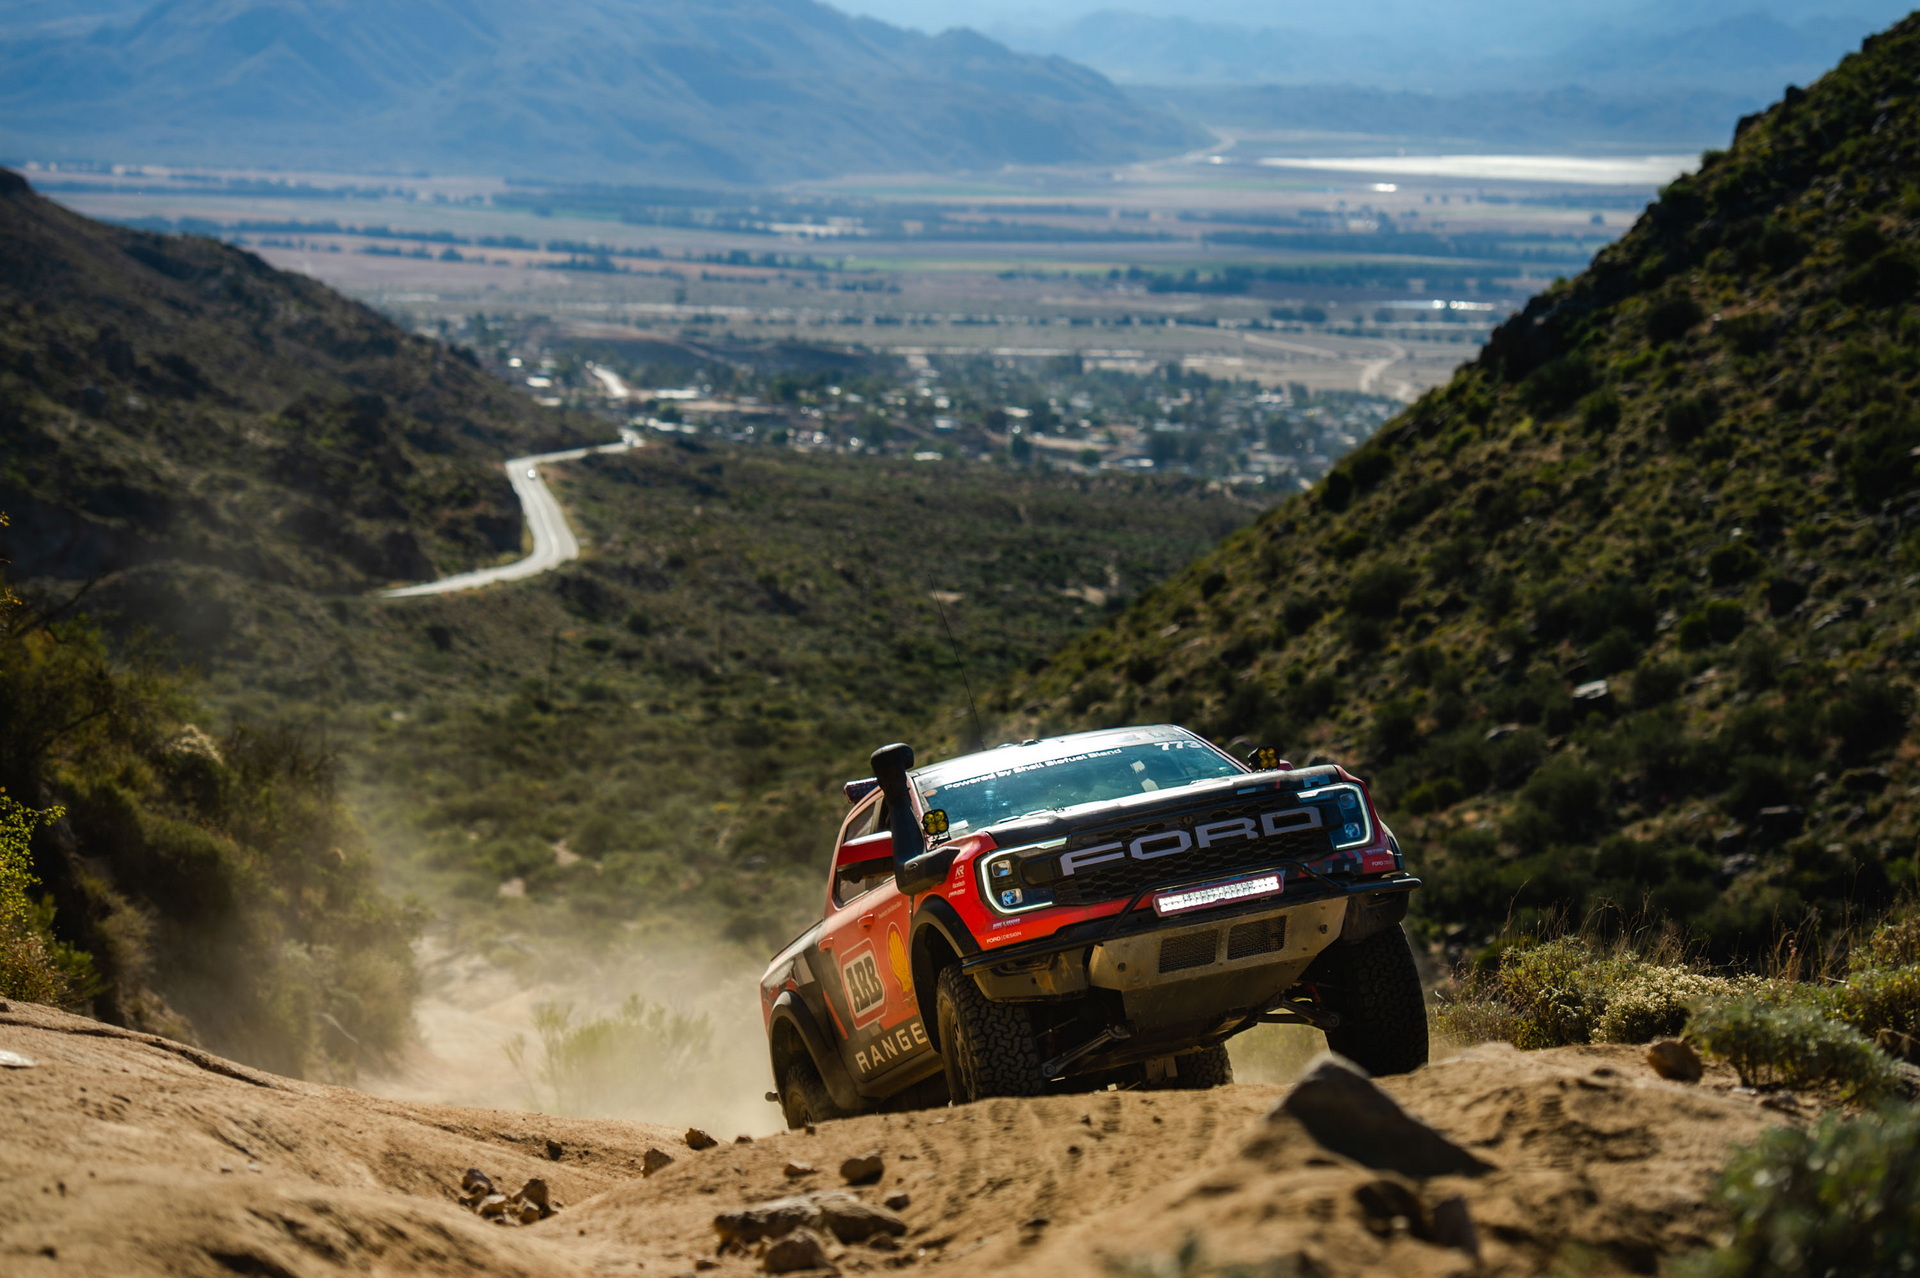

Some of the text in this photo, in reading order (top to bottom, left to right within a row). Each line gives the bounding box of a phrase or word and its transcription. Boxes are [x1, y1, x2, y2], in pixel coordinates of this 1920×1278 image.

[1154, 740, 1202, 751] 773
[944, 748, 1122, 791] Powered by Shell Biofuel Blend
[1060, 806, 1323, 876] FORD
[986, 931, 1022, 944] FORD DESIGN
[845, 956, 885, 1014] ARB
[855, 1022, 928, 1074] RANGE
